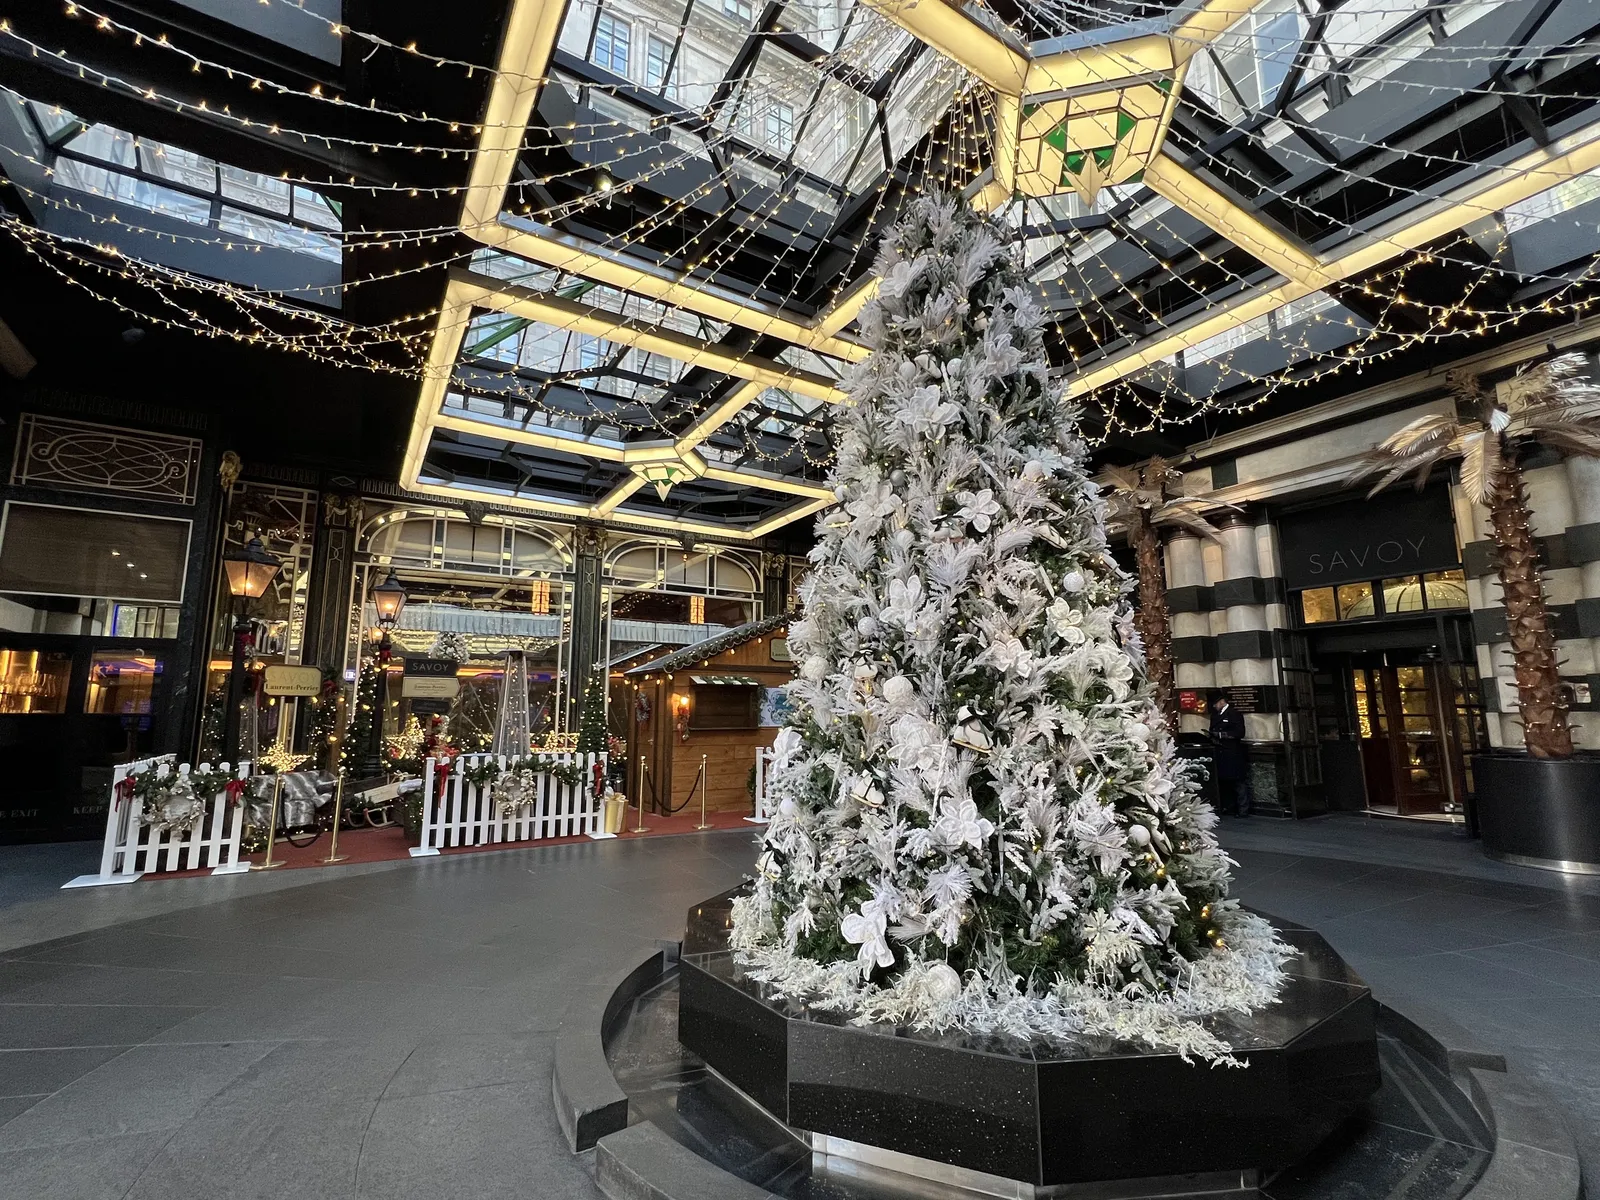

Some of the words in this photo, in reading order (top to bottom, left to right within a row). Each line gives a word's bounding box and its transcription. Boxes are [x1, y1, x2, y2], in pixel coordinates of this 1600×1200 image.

[1309, 535, 1426, 574] SAVOY
[412, 662, 449, 672] SAVOY
[265, 683, 320, 691] Laurent-Perrier
[11, 808, 41, 818] EXIT
[73, 805, 103, 814] KEEP
